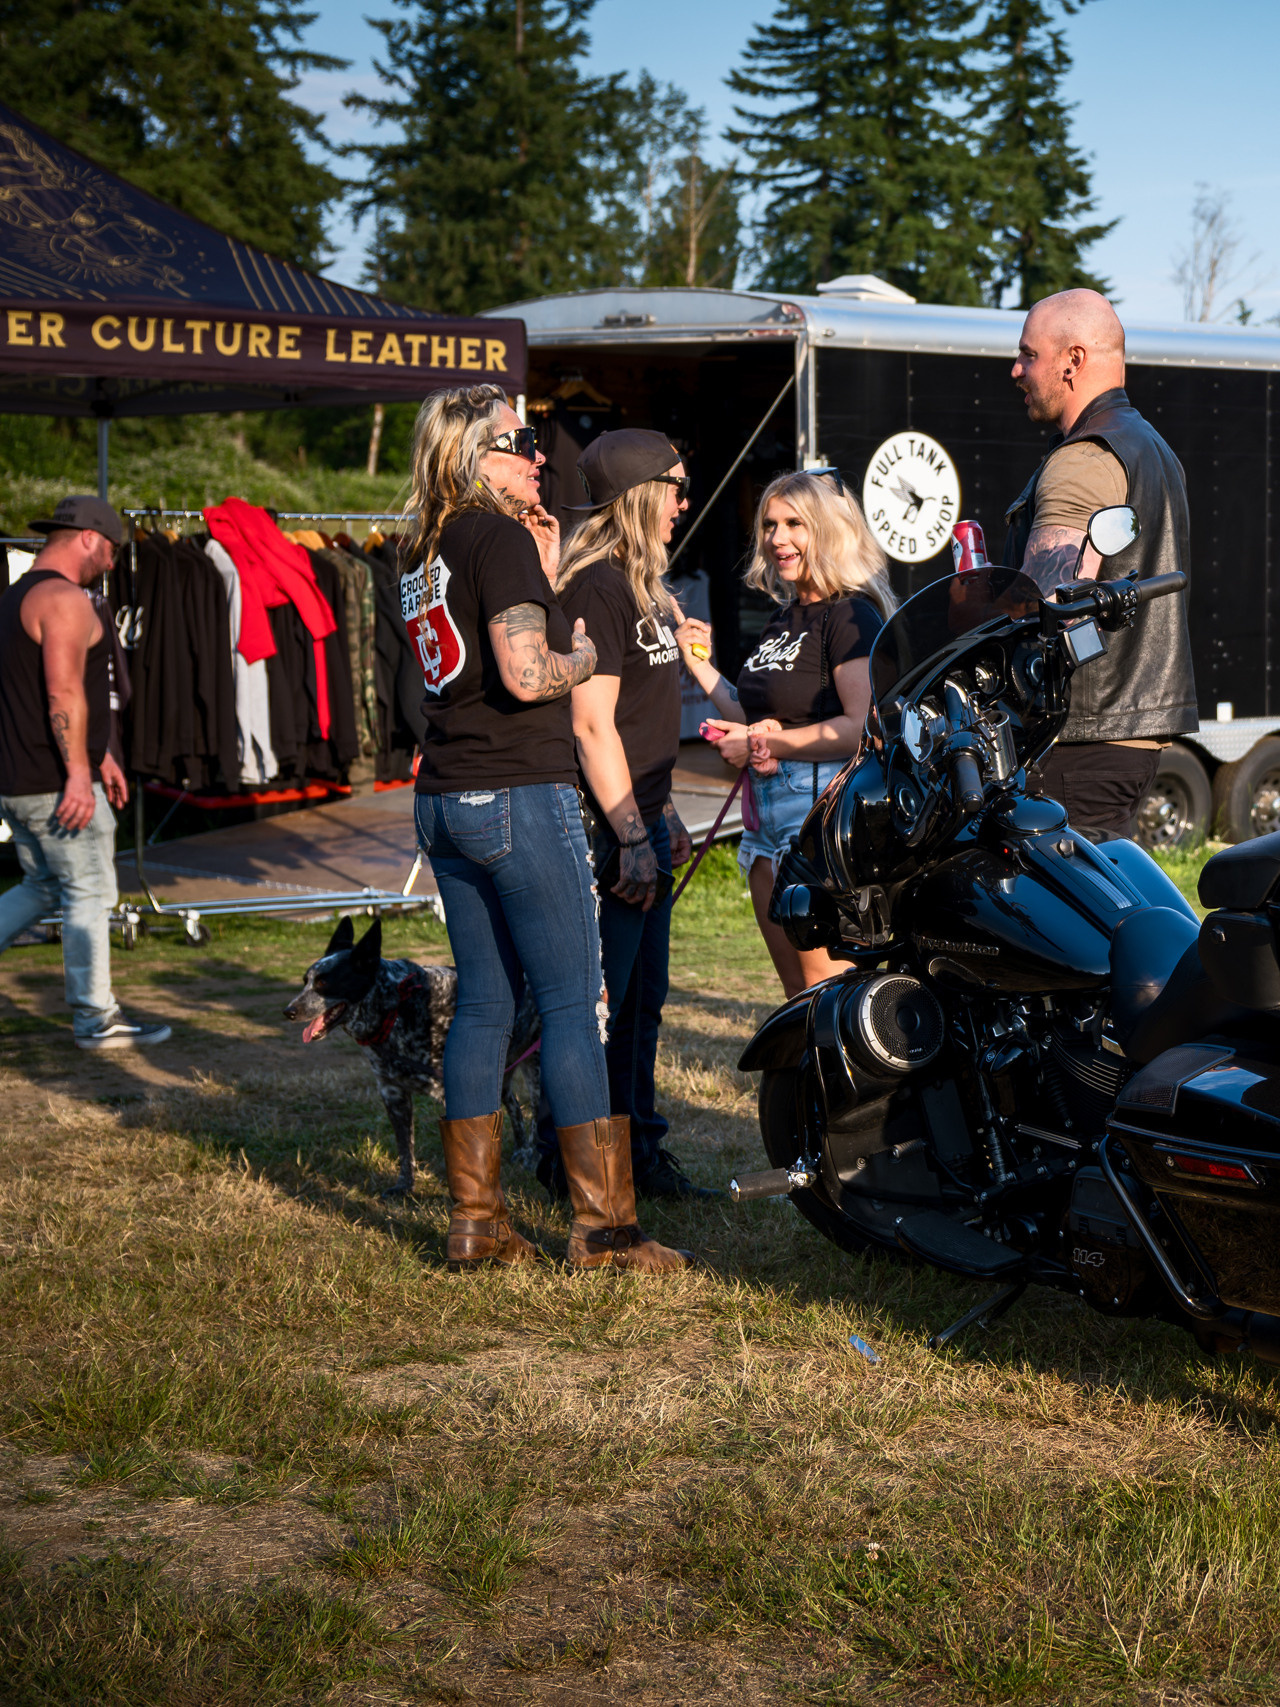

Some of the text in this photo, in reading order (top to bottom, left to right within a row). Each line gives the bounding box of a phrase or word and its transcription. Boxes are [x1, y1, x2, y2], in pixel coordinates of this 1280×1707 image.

[91, 314, 302, 360] CULTURE
[325, 328, 508, 373] LEATHER
[871, 439, 947, 489] FULL TANK
[872, 495, 954, 555] SPEED SHOP
[401, 583, 441, 616] GARE
[1073, 1247, 1105, 1267] 114
